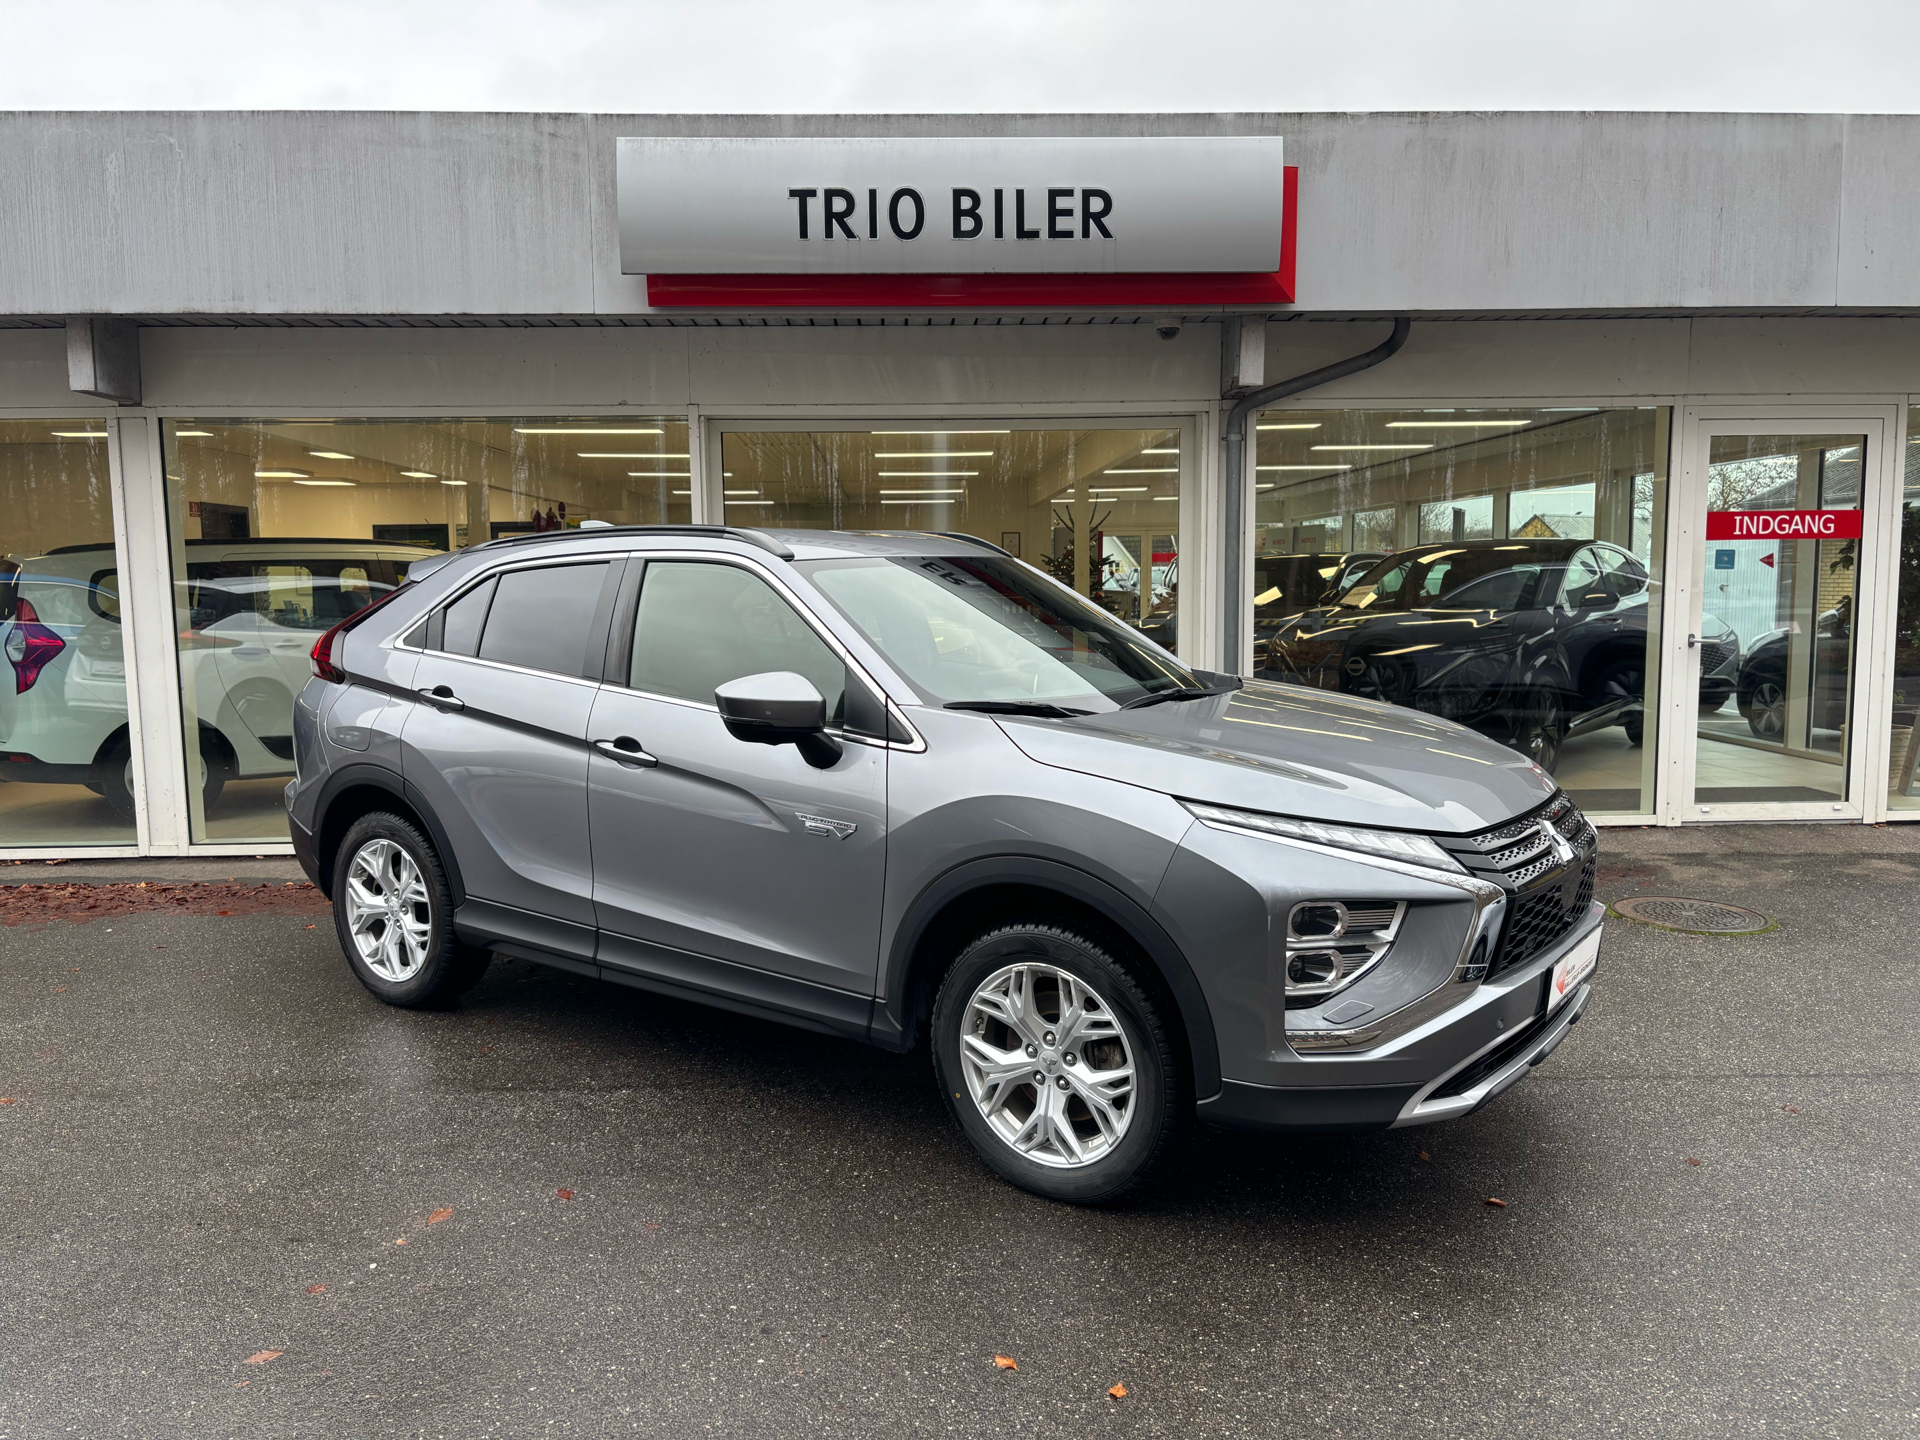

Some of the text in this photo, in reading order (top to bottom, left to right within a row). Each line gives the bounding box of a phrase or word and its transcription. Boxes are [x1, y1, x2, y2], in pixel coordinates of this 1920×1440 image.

[788, 187, 1115, 241] TRIO BILER
[1733, 514, 1835, 535] INDGANG
[827, 819, 852, 829] HYBRID
